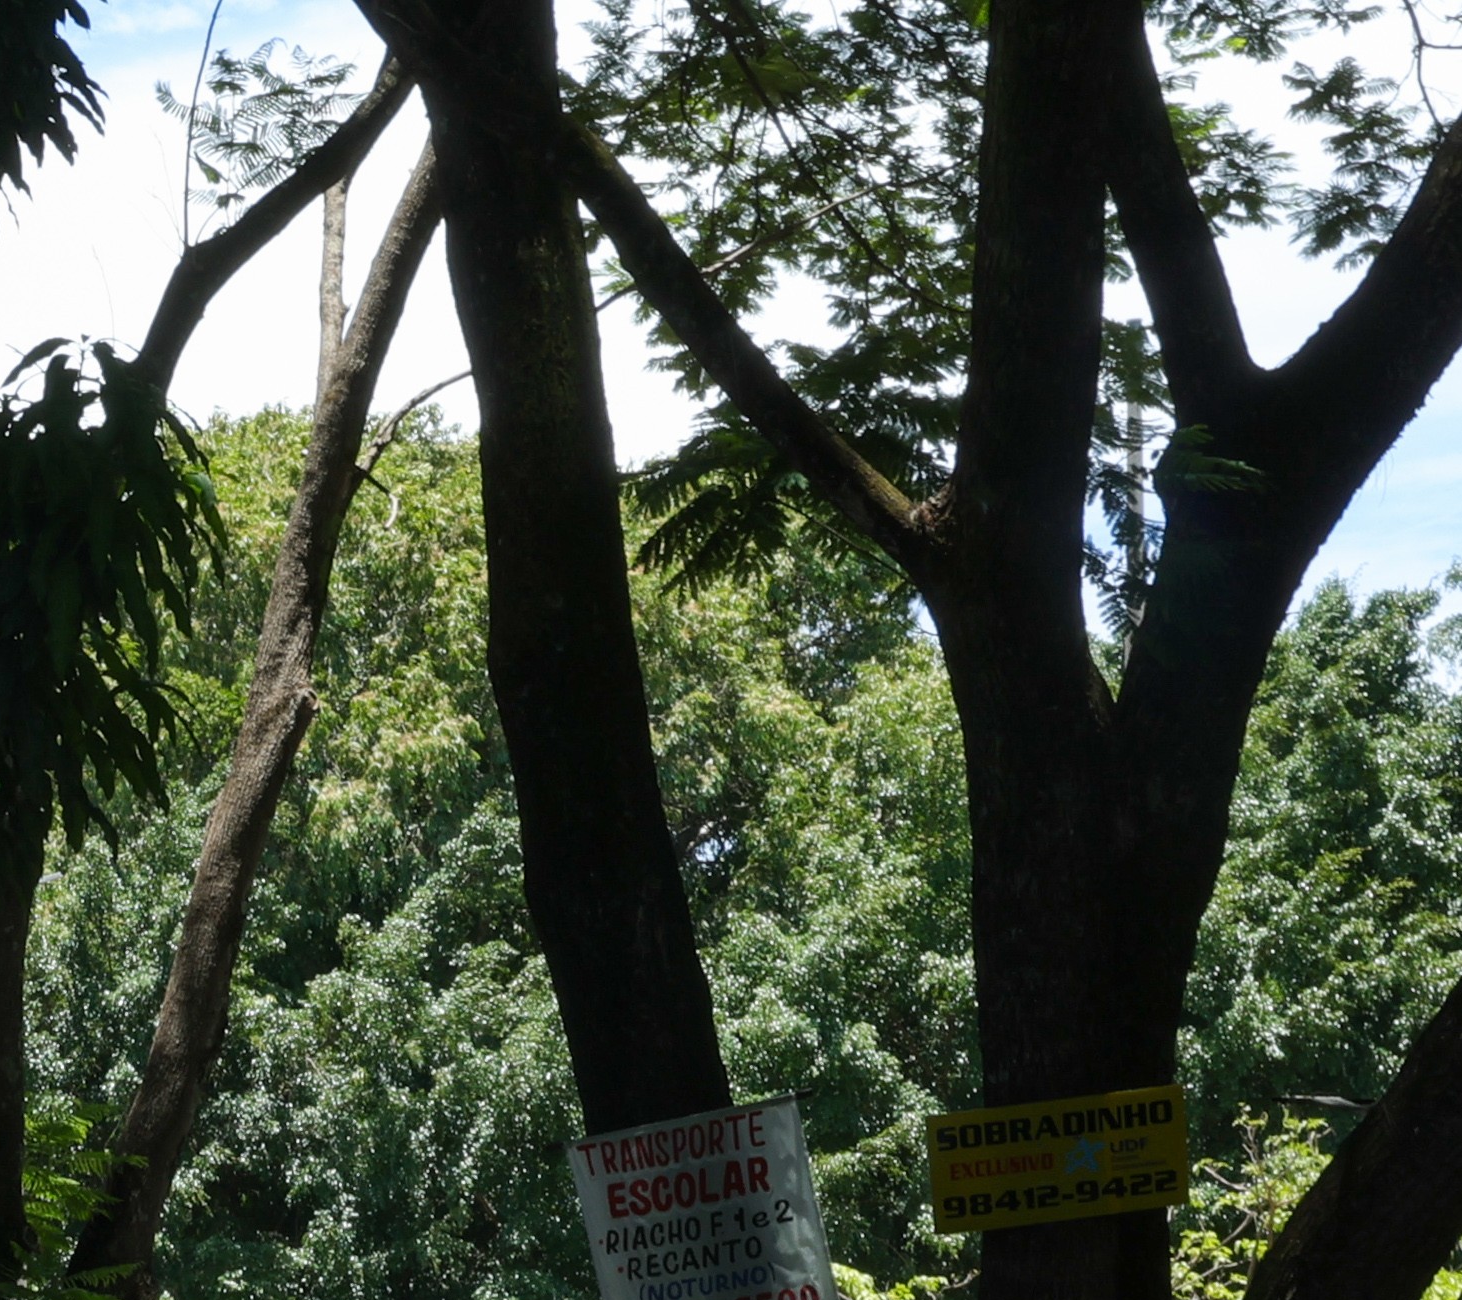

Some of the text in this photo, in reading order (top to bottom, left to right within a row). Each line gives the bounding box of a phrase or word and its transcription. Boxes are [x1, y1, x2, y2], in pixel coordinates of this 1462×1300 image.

[576, 1110, 766, 1177] TRANSPORTE
[936, 1098, 1174, 1152] SOBRADINHO
[606, 1156, 772, 1220] ESCOLAR
[949, 1152, 1055, 1182] EXCLUSIVO
[943, 1169, 1178, 1219] 98412-9422
[605, 1215, 702, 1255] RIACHO
[627, 1235, 763, 1281] RECANTO
